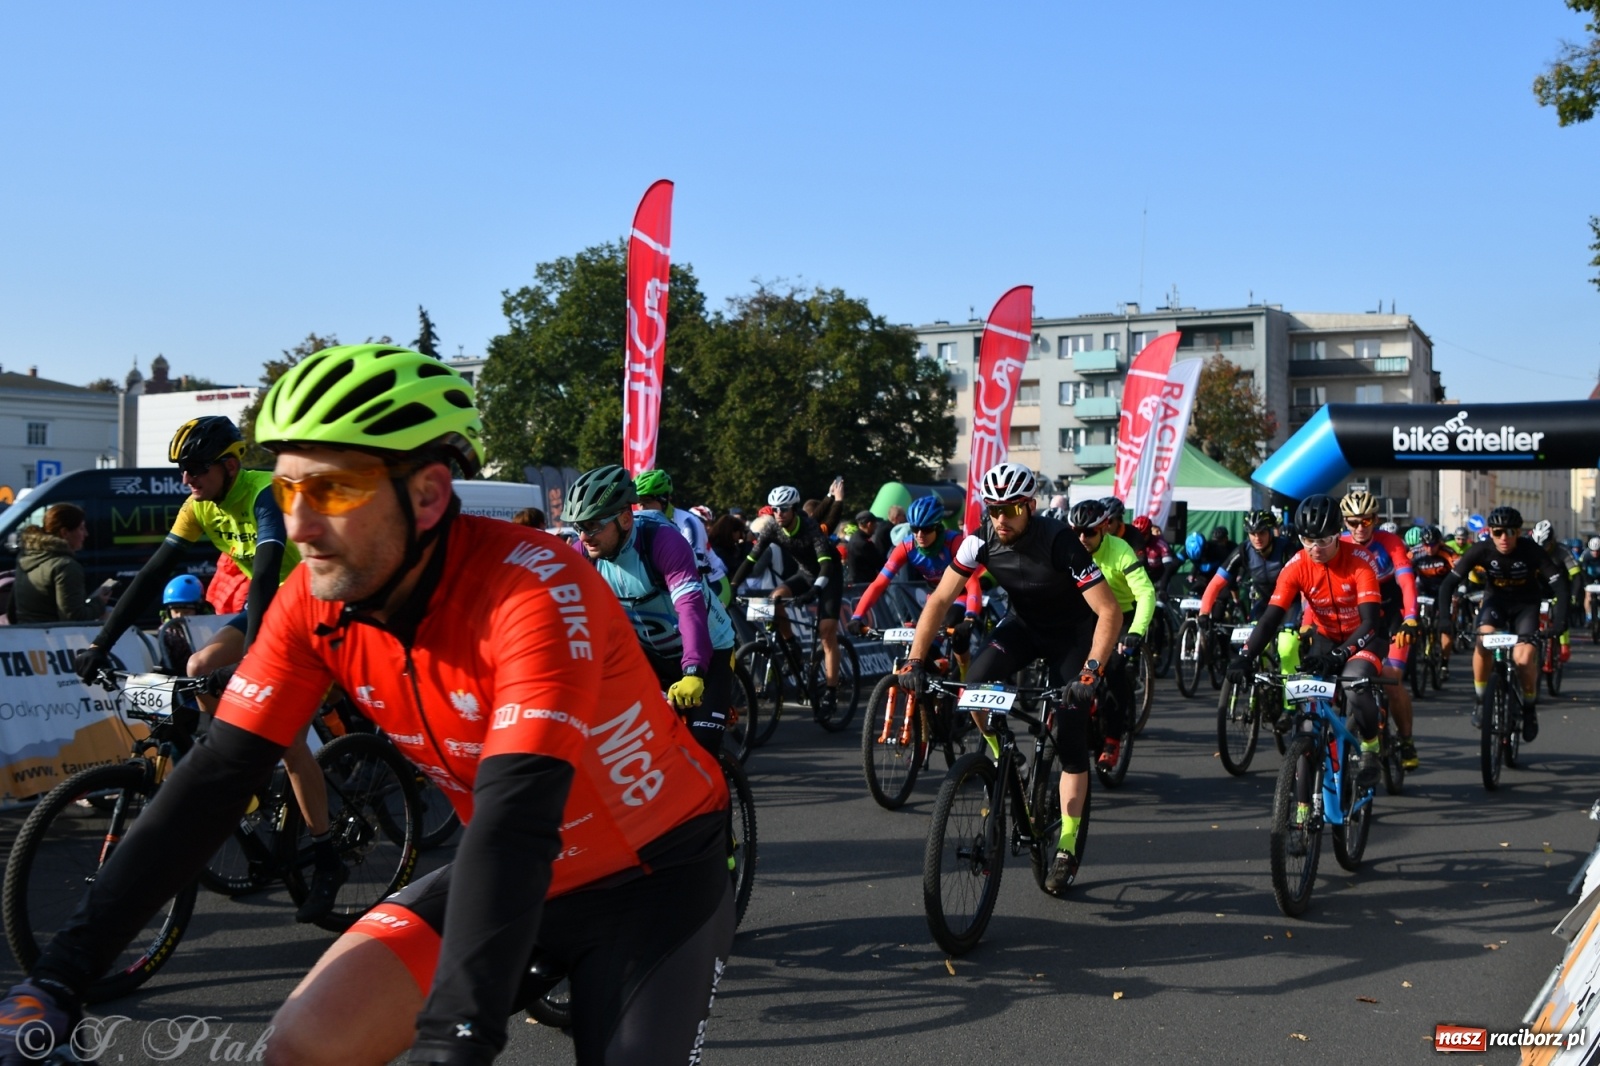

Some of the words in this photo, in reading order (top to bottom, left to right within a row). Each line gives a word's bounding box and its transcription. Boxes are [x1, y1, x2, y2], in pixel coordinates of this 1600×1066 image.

[1393, 426, 1449, 451] bike
[1456, 426, 1545, 451] atelier
[151, 478, 190, 495] bike
[215, 530, 257, 543] TREK
[548, 583, 593, 661] BIKE
[1294, 683, 1327, 694] 1240
[970, 693, 1006, 705] 3170
[590, 701, 665, 807] Nice
